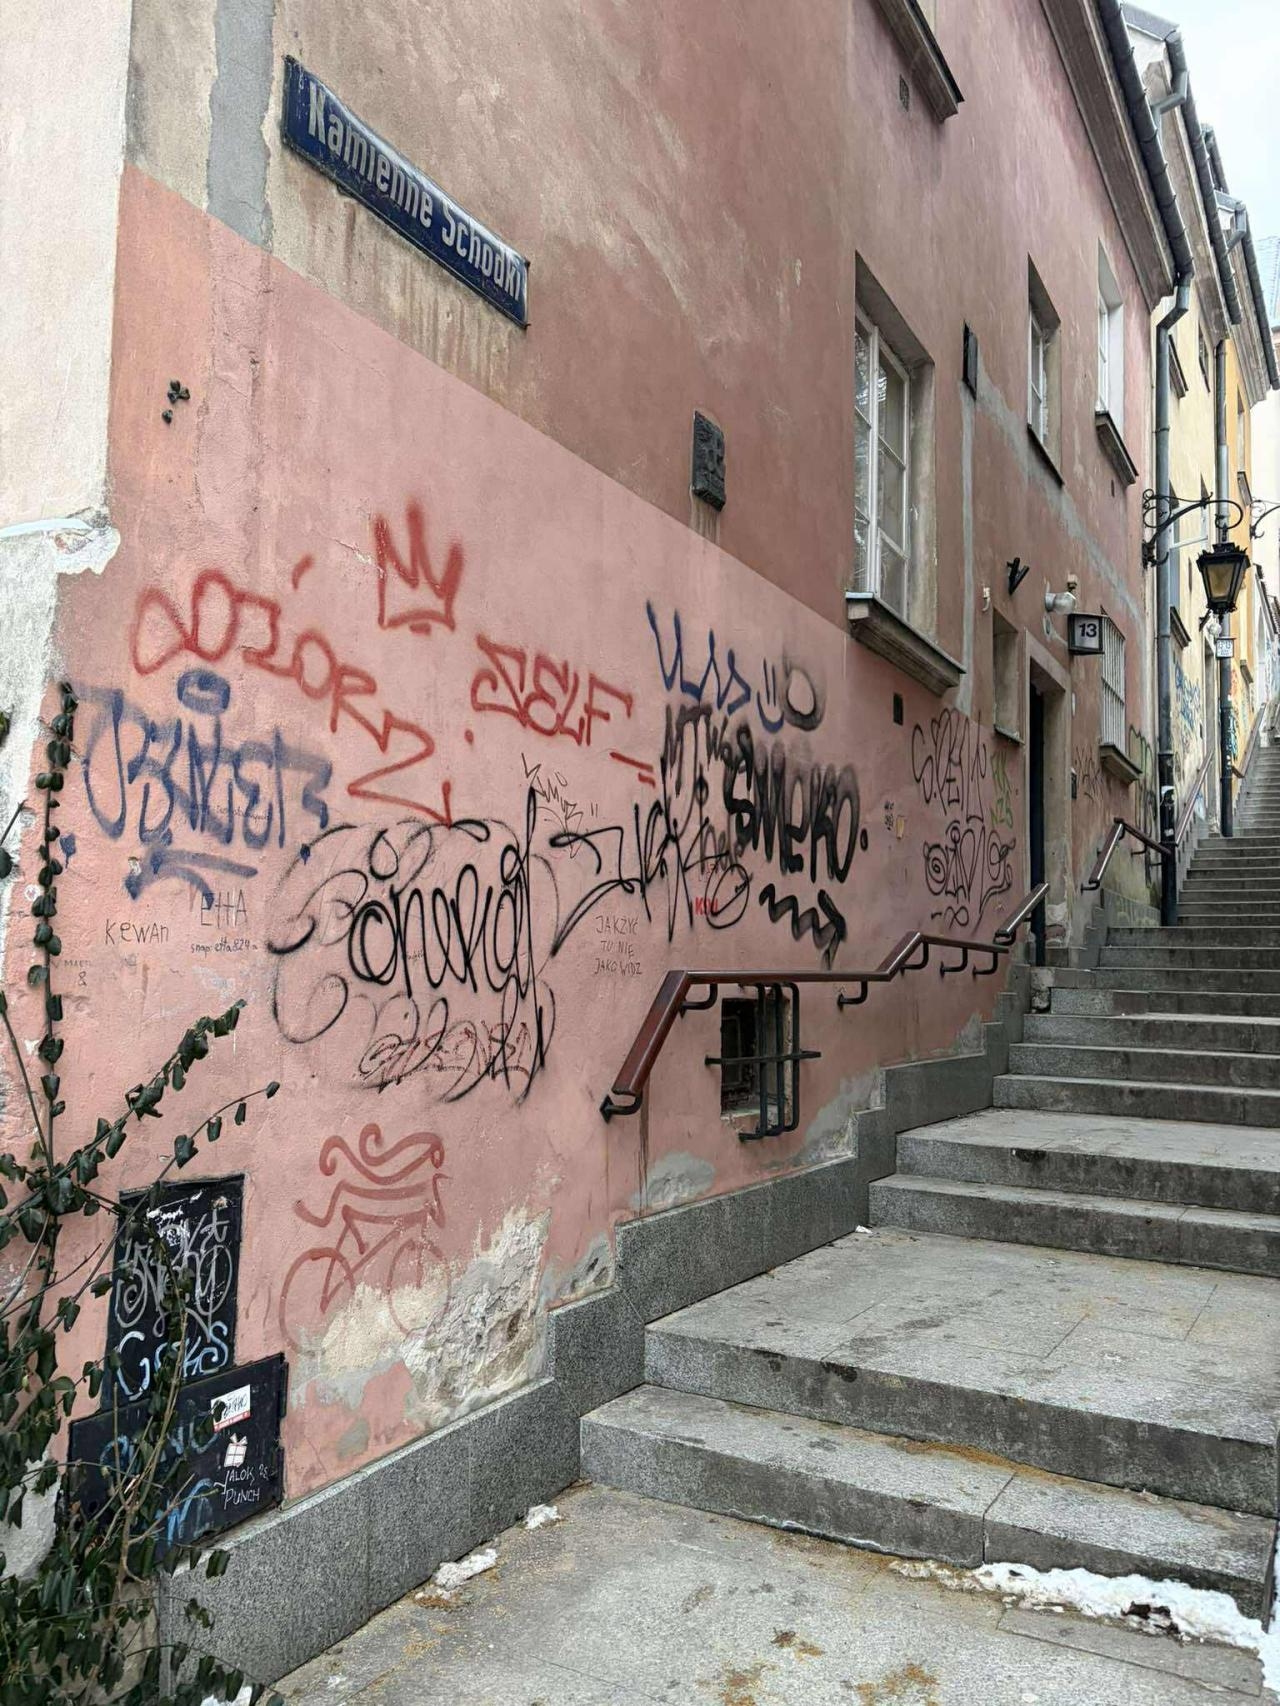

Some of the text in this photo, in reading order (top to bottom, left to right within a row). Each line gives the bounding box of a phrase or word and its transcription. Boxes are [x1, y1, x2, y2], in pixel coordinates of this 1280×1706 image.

[308, 81, 521, 301] Kamienne Schodki
[1078, 622, 1097, 638] 13
[223, 1487, 260, 1510] PUNCH
